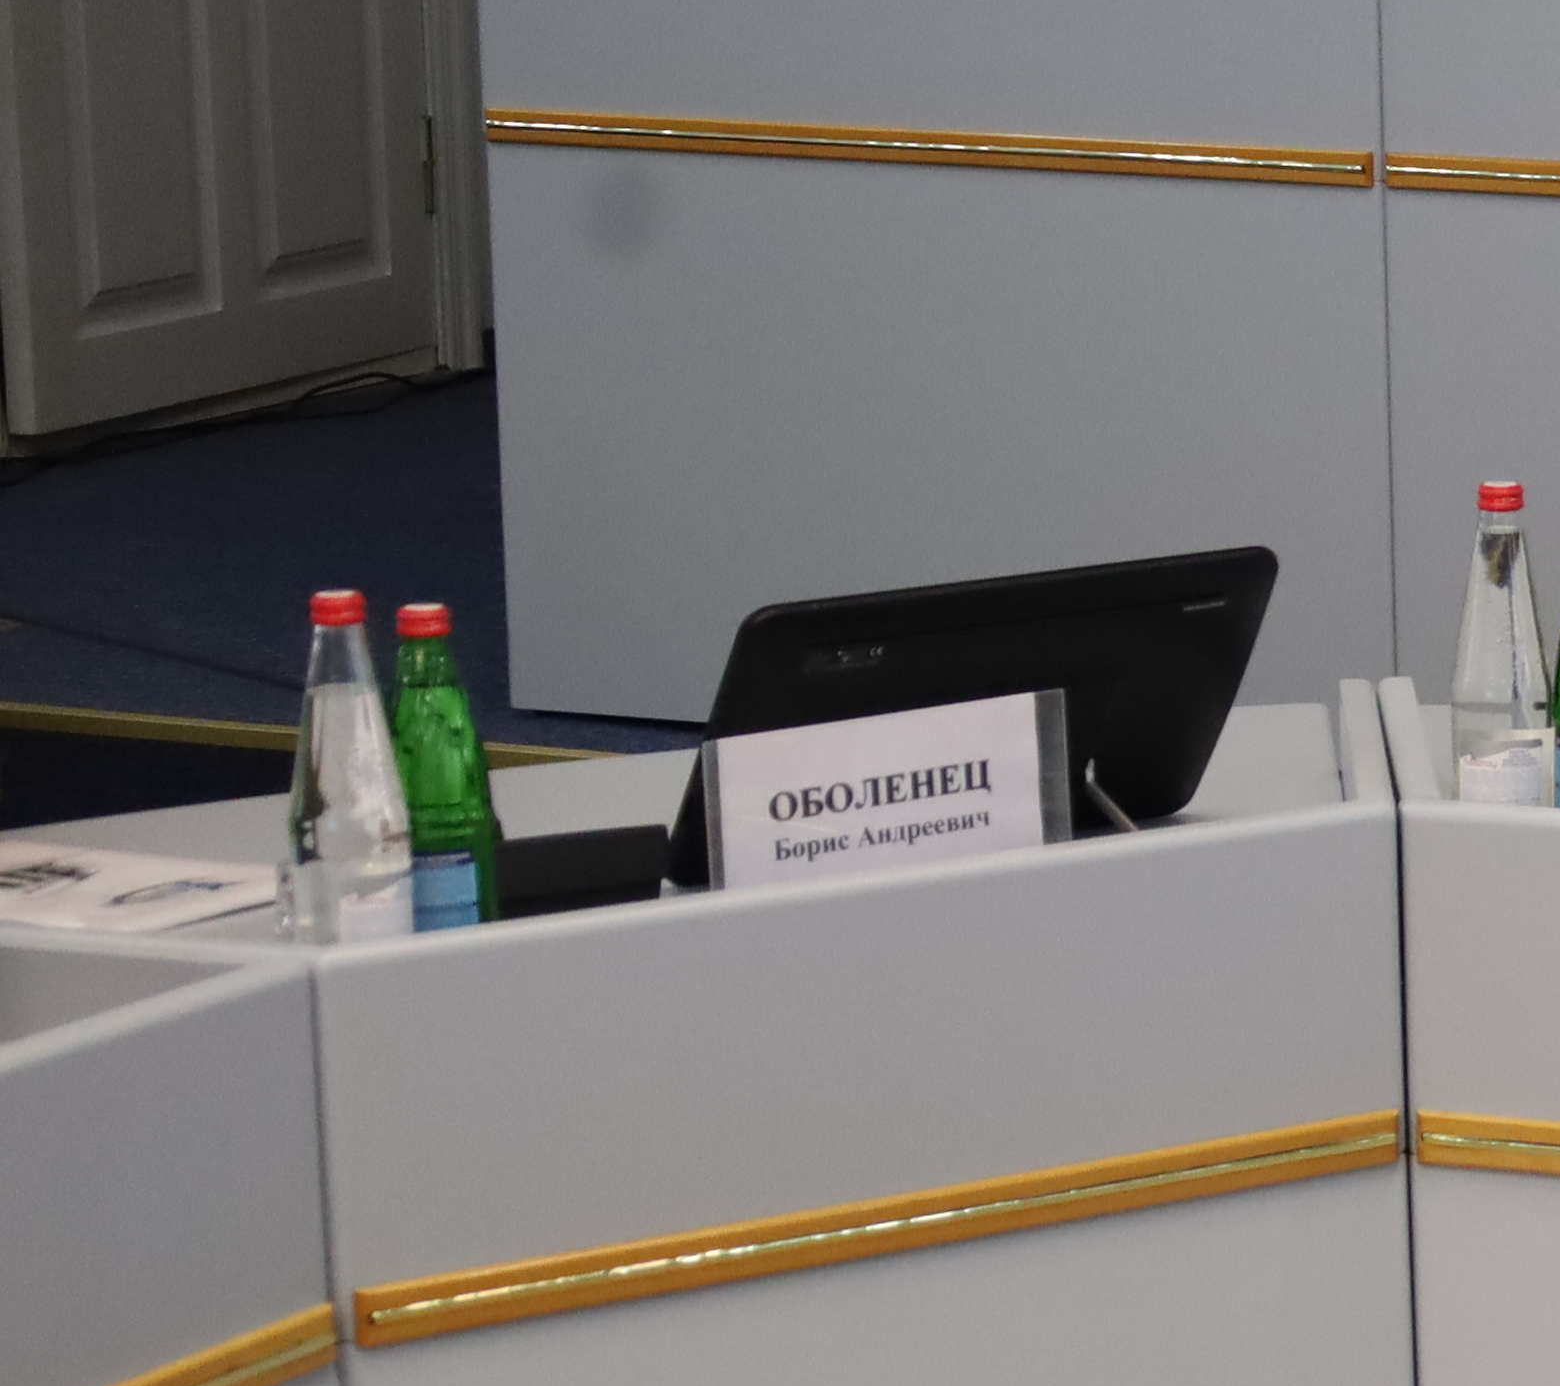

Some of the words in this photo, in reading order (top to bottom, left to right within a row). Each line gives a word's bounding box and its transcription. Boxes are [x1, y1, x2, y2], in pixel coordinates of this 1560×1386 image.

[768, 759, 993, 822] ОБОЛЕНЕЦ
[774, 834, 850, 862] Борис
[857, 811, 991, 846] Андреевич
